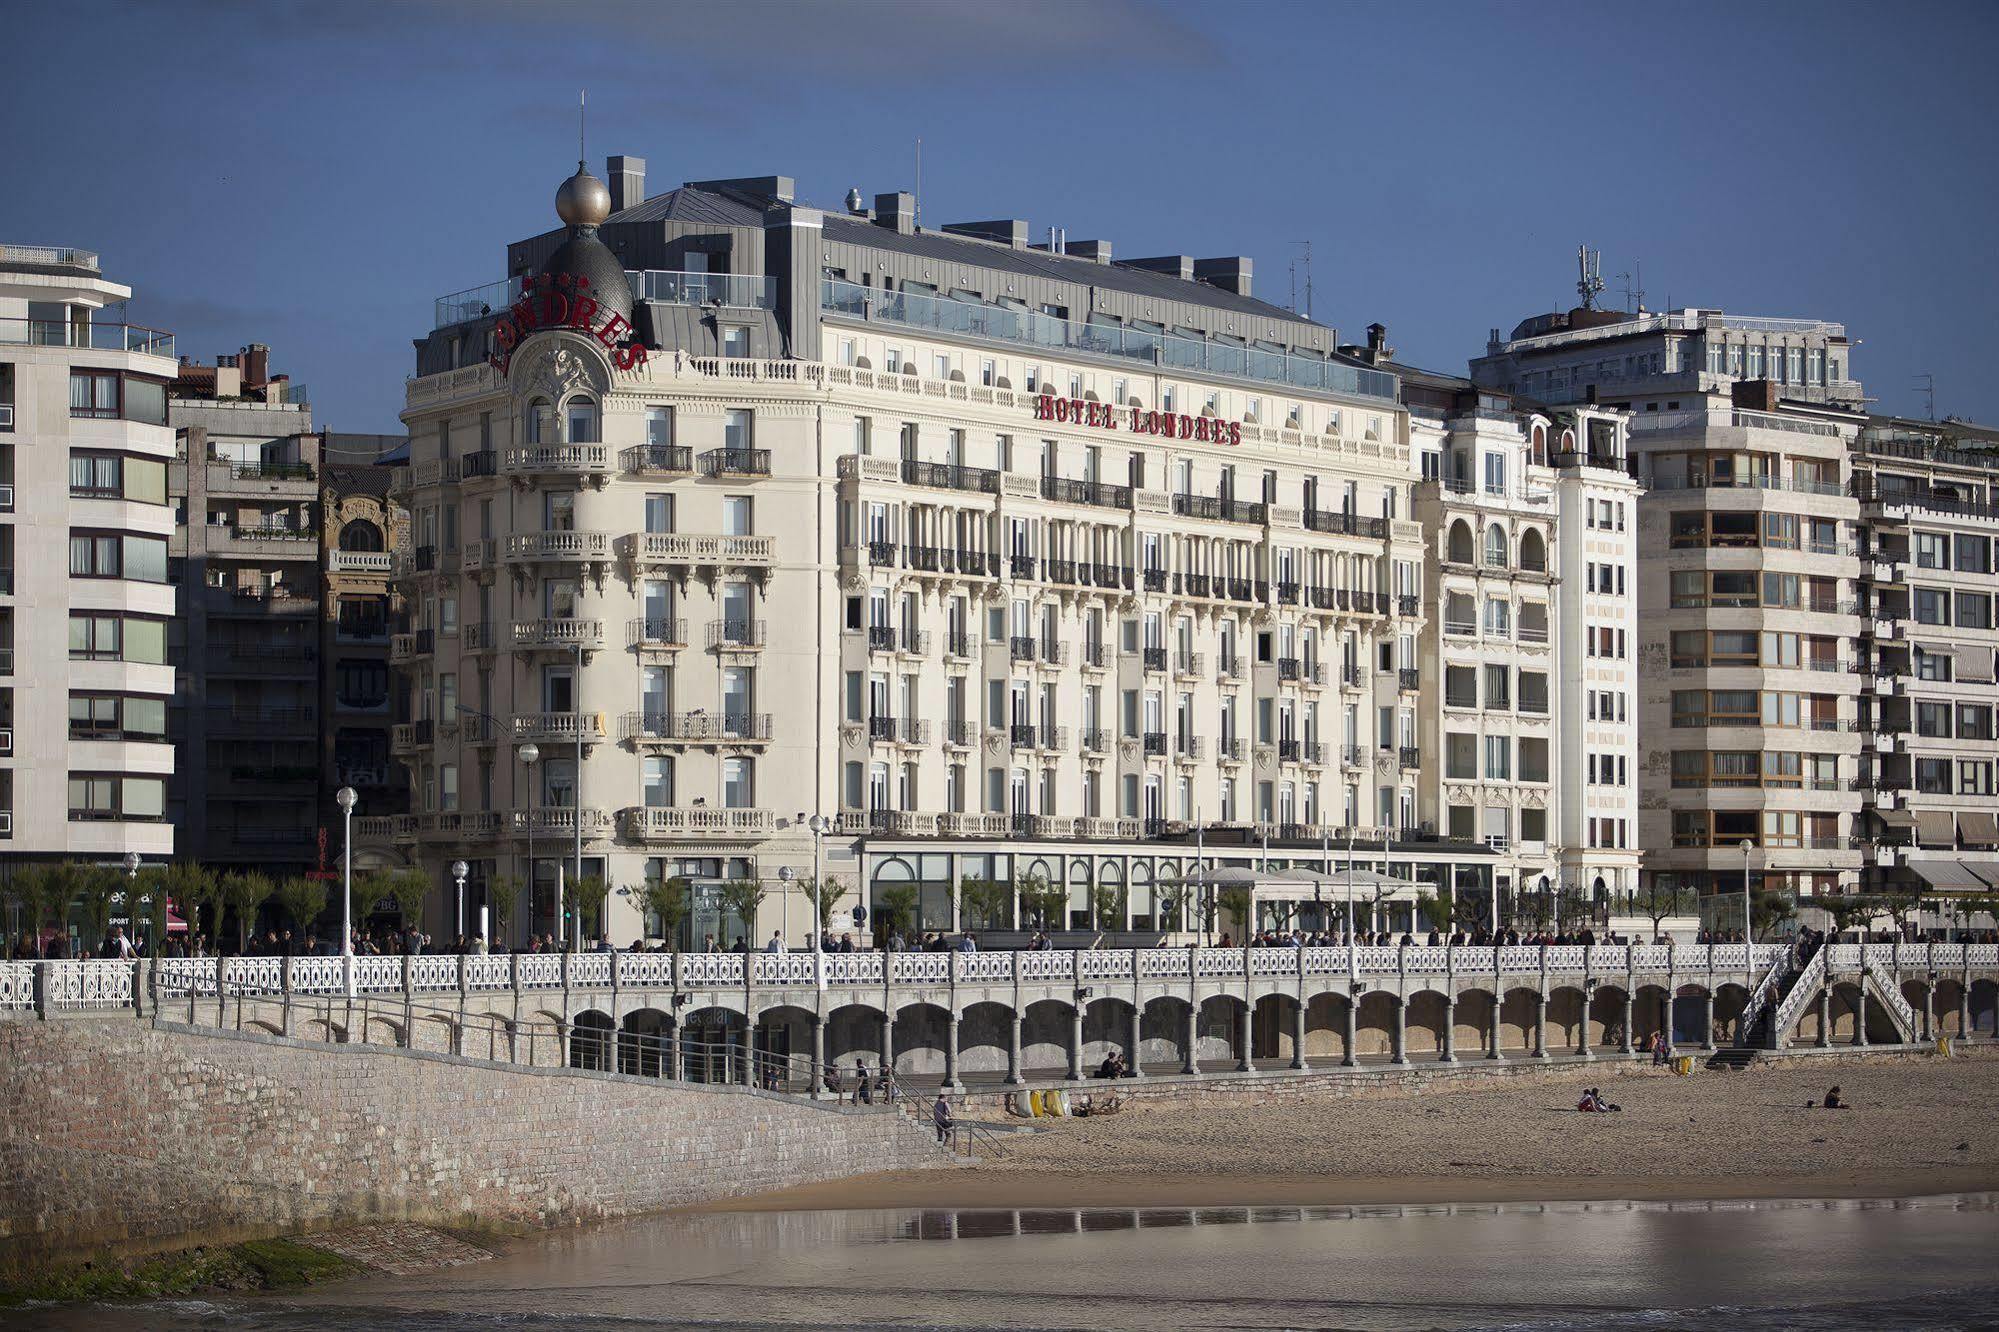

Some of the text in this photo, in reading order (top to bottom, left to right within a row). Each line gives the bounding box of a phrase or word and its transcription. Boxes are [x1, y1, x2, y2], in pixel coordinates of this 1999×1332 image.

[490, 289, 647, 378] LONDRES
[1039, 394, 1241, 446] HOTEL LONDRES
[108, 917, 130, 926] SPORT
